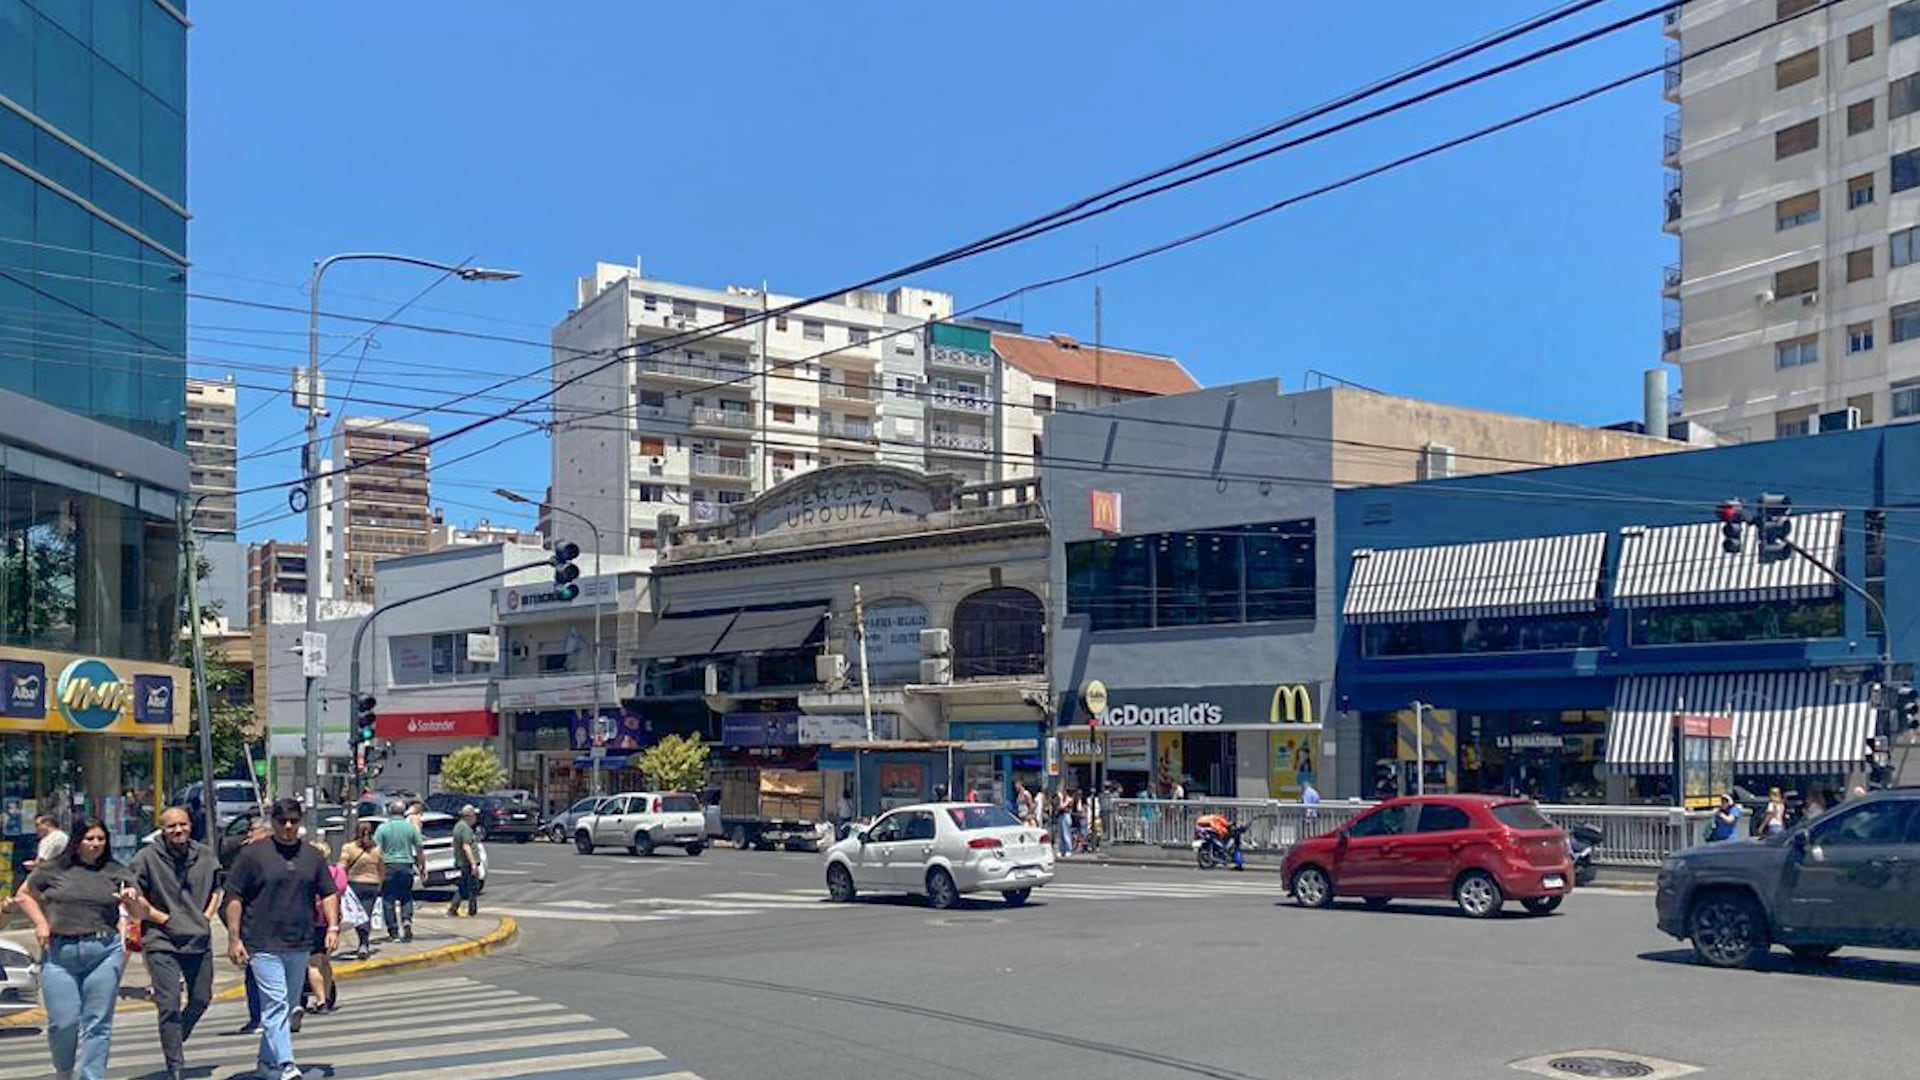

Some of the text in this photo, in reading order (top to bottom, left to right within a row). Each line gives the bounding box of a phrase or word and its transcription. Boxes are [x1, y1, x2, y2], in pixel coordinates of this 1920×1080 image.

[784, 481, 896, 508] MERCADO
[417, 719, 456, 731] Santander
[1061, 740, 1103, 756] POSTRS
